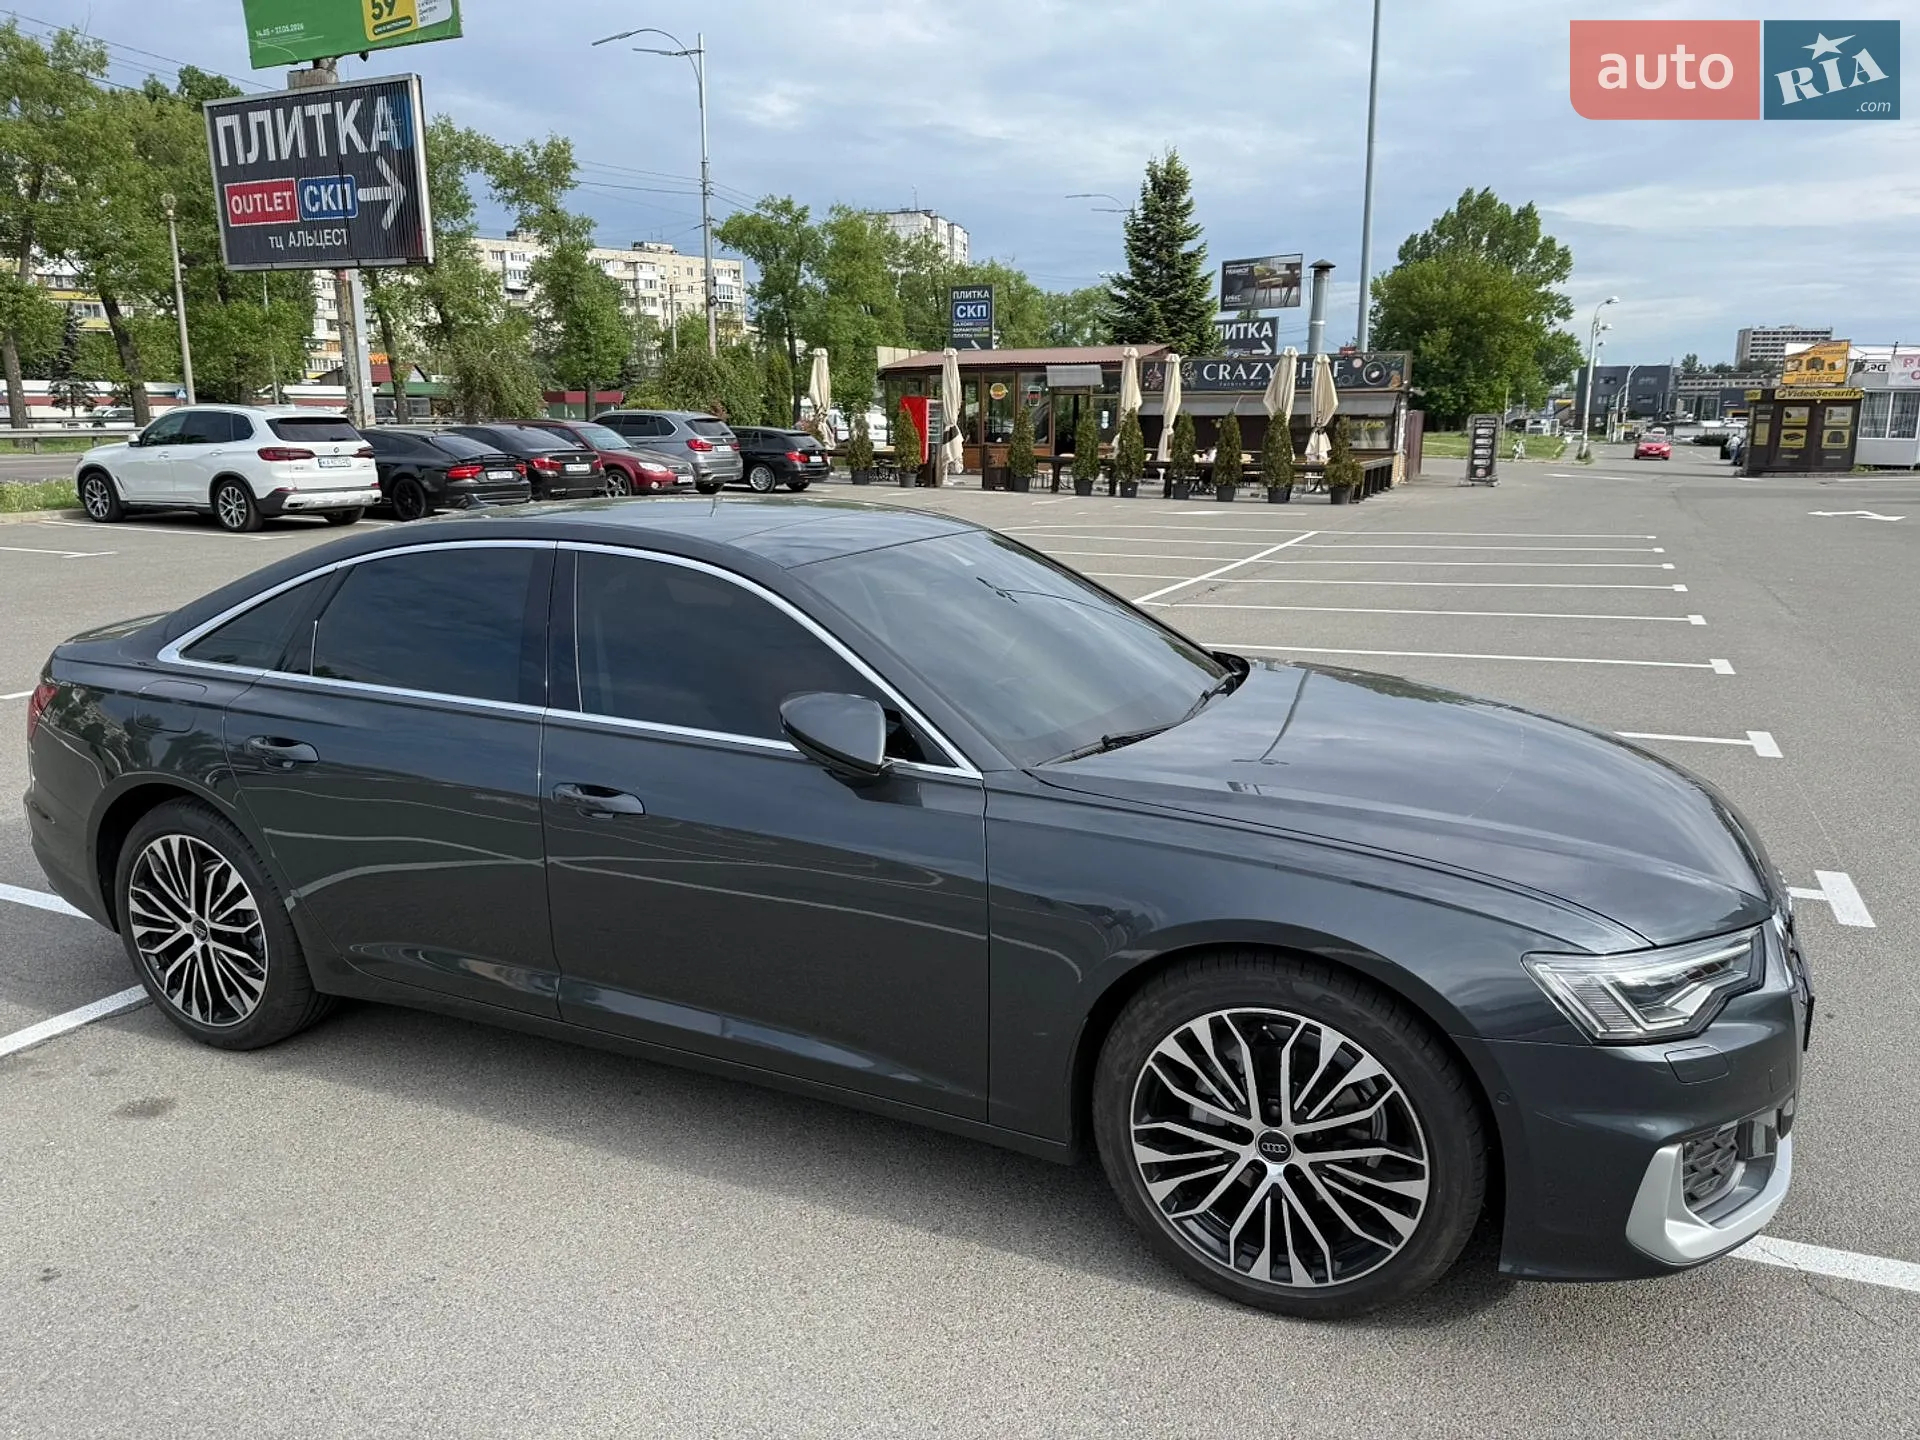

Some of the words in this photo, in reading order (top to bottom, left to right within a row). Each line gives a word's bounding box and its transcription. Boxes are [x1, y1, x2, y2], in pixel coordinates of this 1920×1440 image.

[214, 95, 403, 168] ПЛИТКА
[230, 189, 293, 215] OUTLET
[303, 182, 353, 212] СКП
[288, 228, 349, 249] АЛЬЦЕСТ
[952, 290, 990, 299] ПЛИТКА
[956, 304, 987, 318] СКП
[1203, 362, 1280, 381] CRAZY
